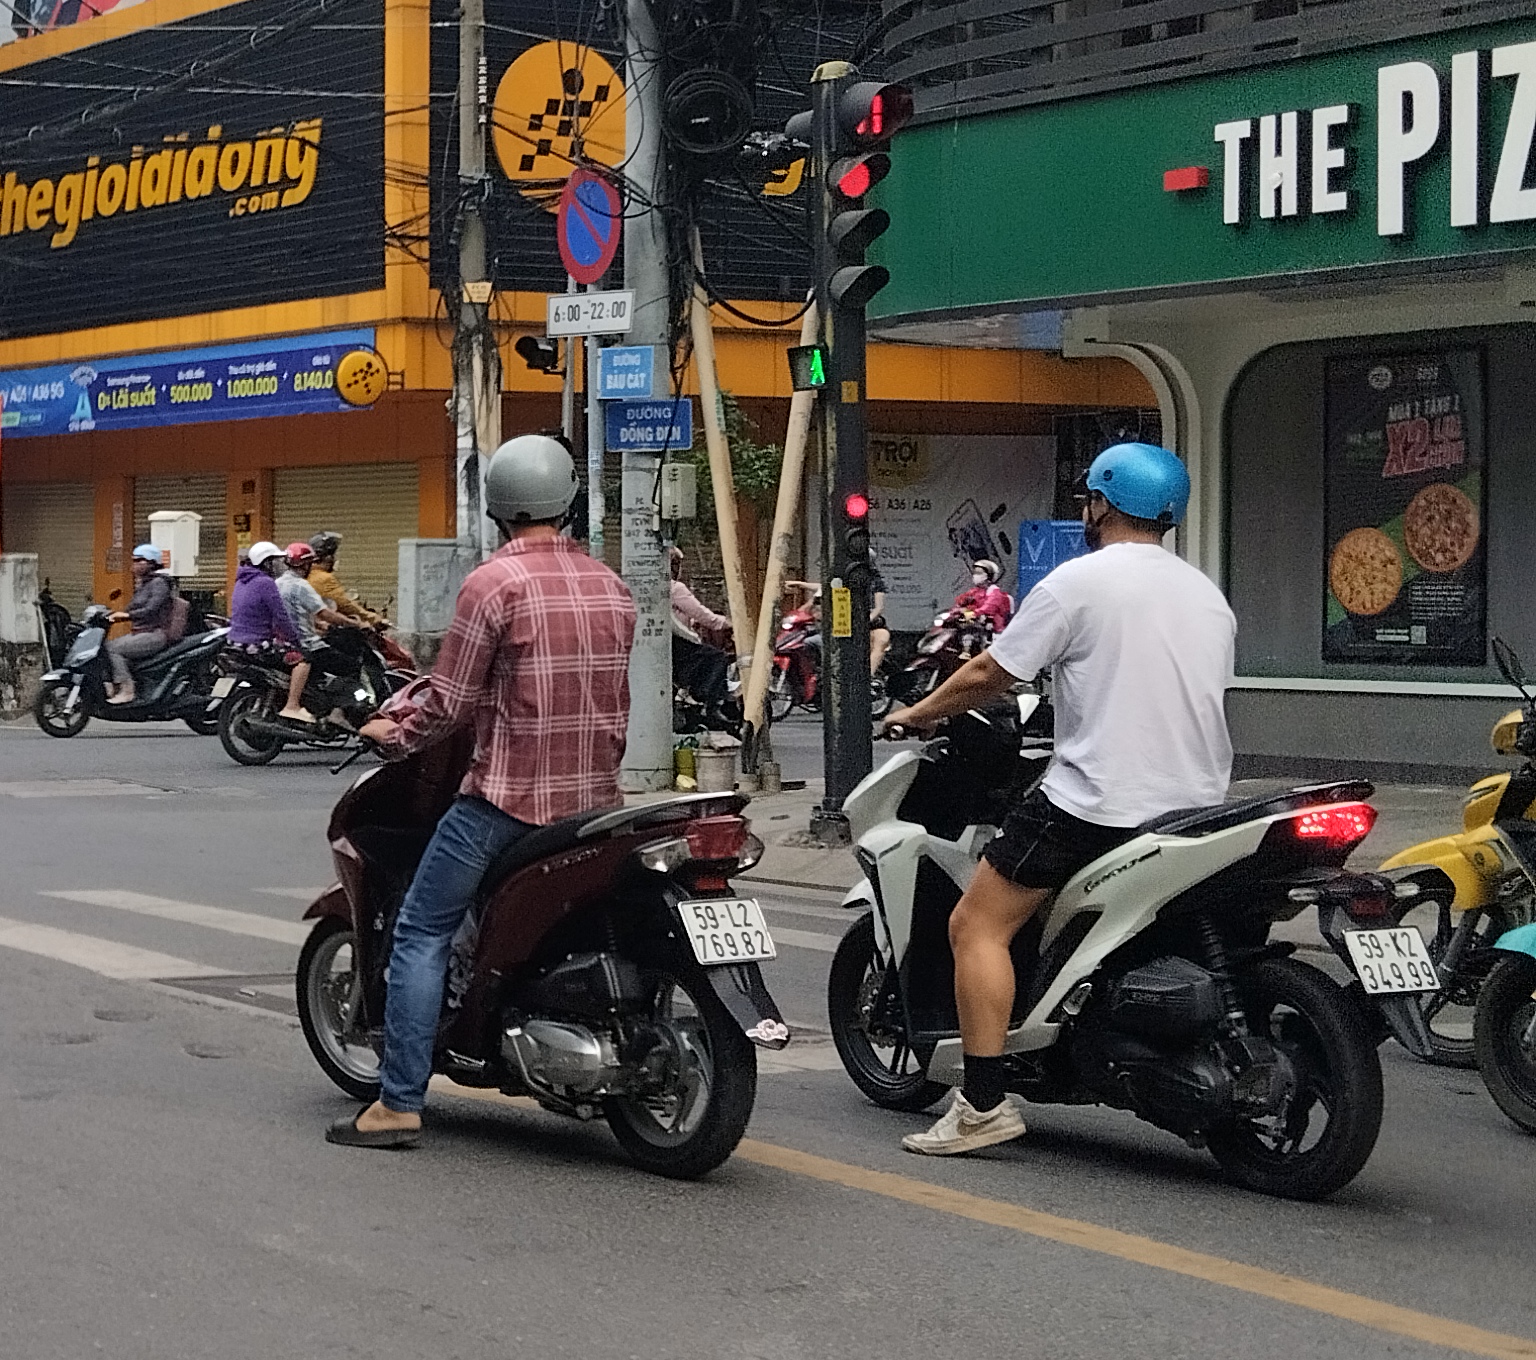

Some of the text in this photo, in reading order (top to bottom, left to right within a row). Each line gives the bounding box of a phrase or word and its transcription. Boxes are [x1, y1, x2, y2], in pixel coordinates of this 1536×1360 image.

[1214, 104, 1350, 225] THE
[170, 381, 214, 404] 500.000
[692, 902, 754, 931] 59-L2
[695, 929, 771, 960] 769.82
[1357, 931, 1419, 959] 59-K2
[1363, 960, 1437, 991] 349.99
